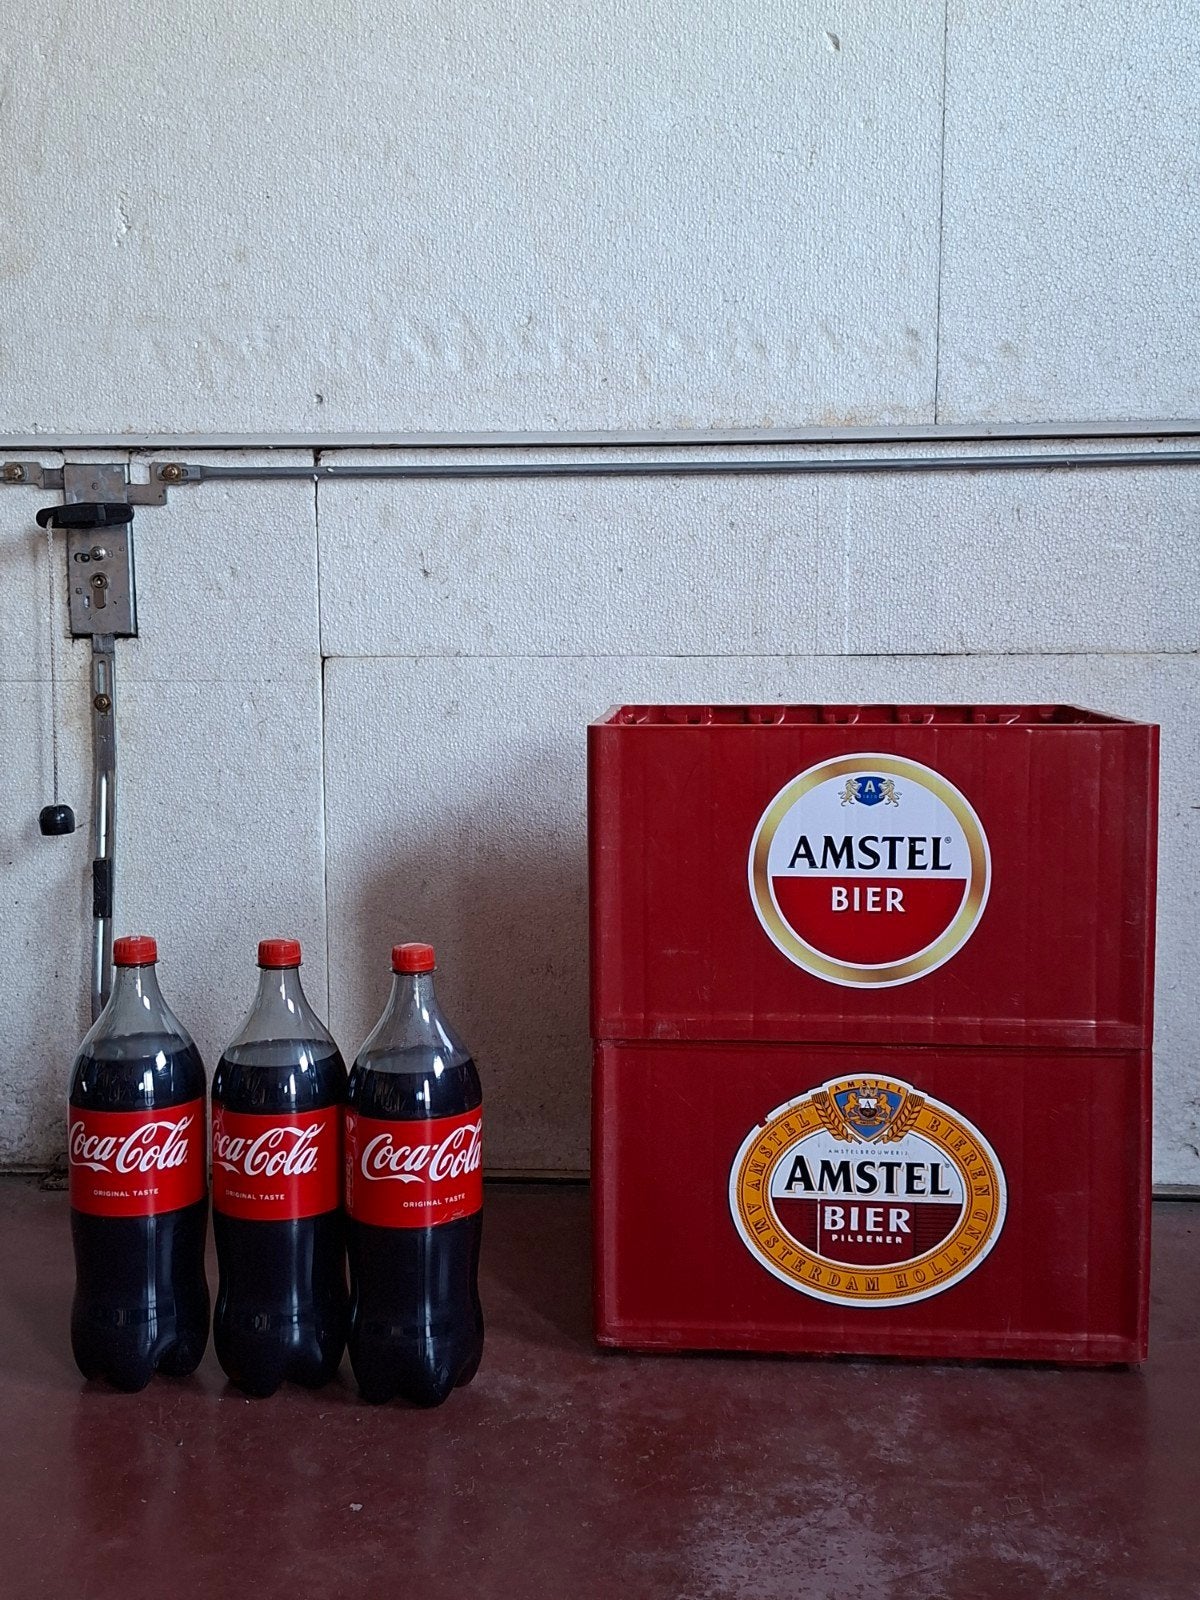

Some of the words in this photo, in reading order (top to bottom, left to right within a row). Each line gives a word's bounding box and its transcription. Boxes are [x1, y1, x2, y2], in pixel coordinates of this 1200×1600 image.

[864, 780, 876, 793] A
[787, 835, 952, 871] AMSTEL
[831, 886, 906, 913] BIER
[834, 1080, 902, 1092] AMSTEL
[70, 1114, 195, 1174] Coca-Cola
[361, 1118, 482, 1184] Coca-Cola
[747, 1112, 811, 1192] AMSTEL
[927, 1117, 992, 1198] BIEREN
[784, 1155, 953, 1197] AMSTEL
[93, 1189, 130, 1197] ORIGINAL
[133, 1188, 159, 1197] TASTE
[225, 1189, 257, 1200] ORIGINAL
[403, 1199, 442, 1208] ORIGINAL
[445, 1193, 466, 1204] TASTE
[824, 1205, 912, 1233] BIER
[746, 1202, 880, 1292] AMSTERDAM
[895, 1209, 989, 1289] HOLLAND
[831, 1234, 903, 1244] PILSENER
